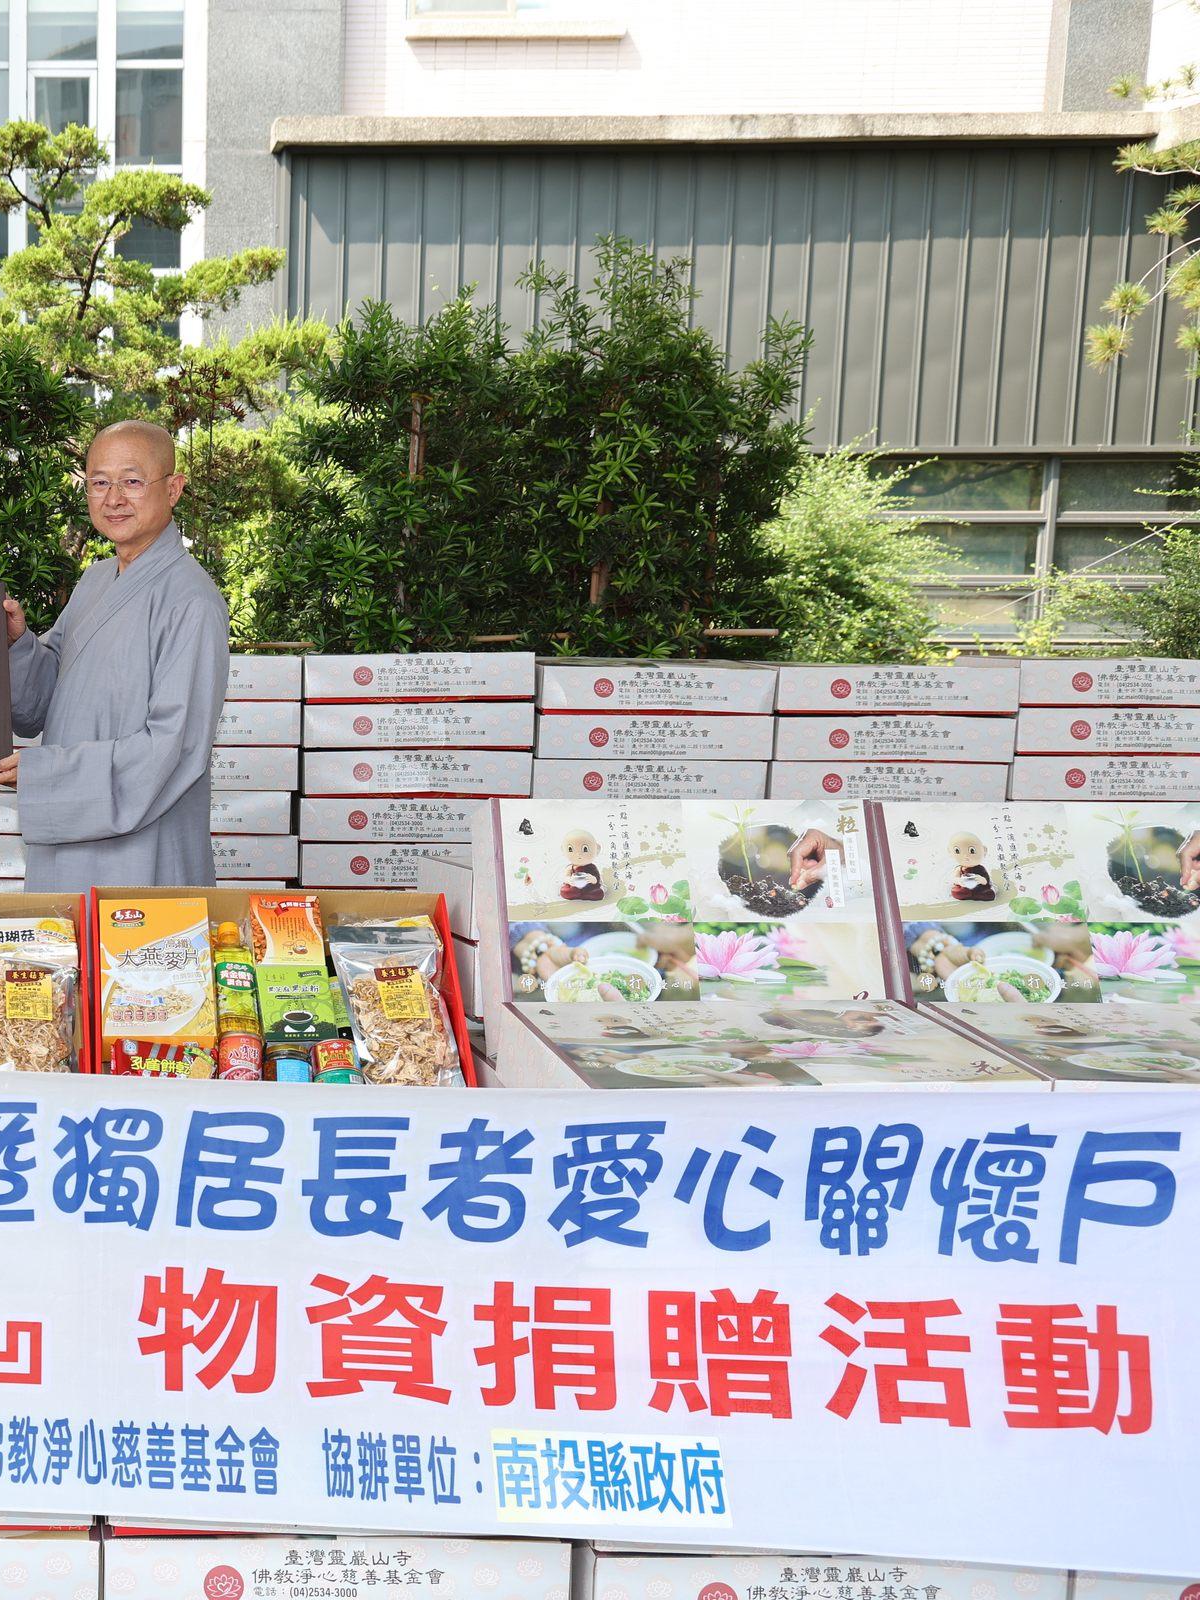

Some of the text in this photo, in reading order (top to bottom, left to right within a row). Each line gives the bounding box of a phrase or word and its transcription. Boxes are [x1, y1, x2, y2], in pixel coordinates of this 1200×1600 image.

[114, 910, 143, 920] 馬玉山
[118, 948, 198, 970] 大燕麥片
[138, 1265, 1152, 1435] 物資捐贈活動
[284, 1549, 412, 1566] 臺灣靈巖山寺
[252, 1569, 445, 1585] 佛教淨心慈善基金會
[779, 1566, 908, 1584] 臺灣靈巖山寺
[746, 1585, 942, 1600] 佛教淨心慈善基金會
